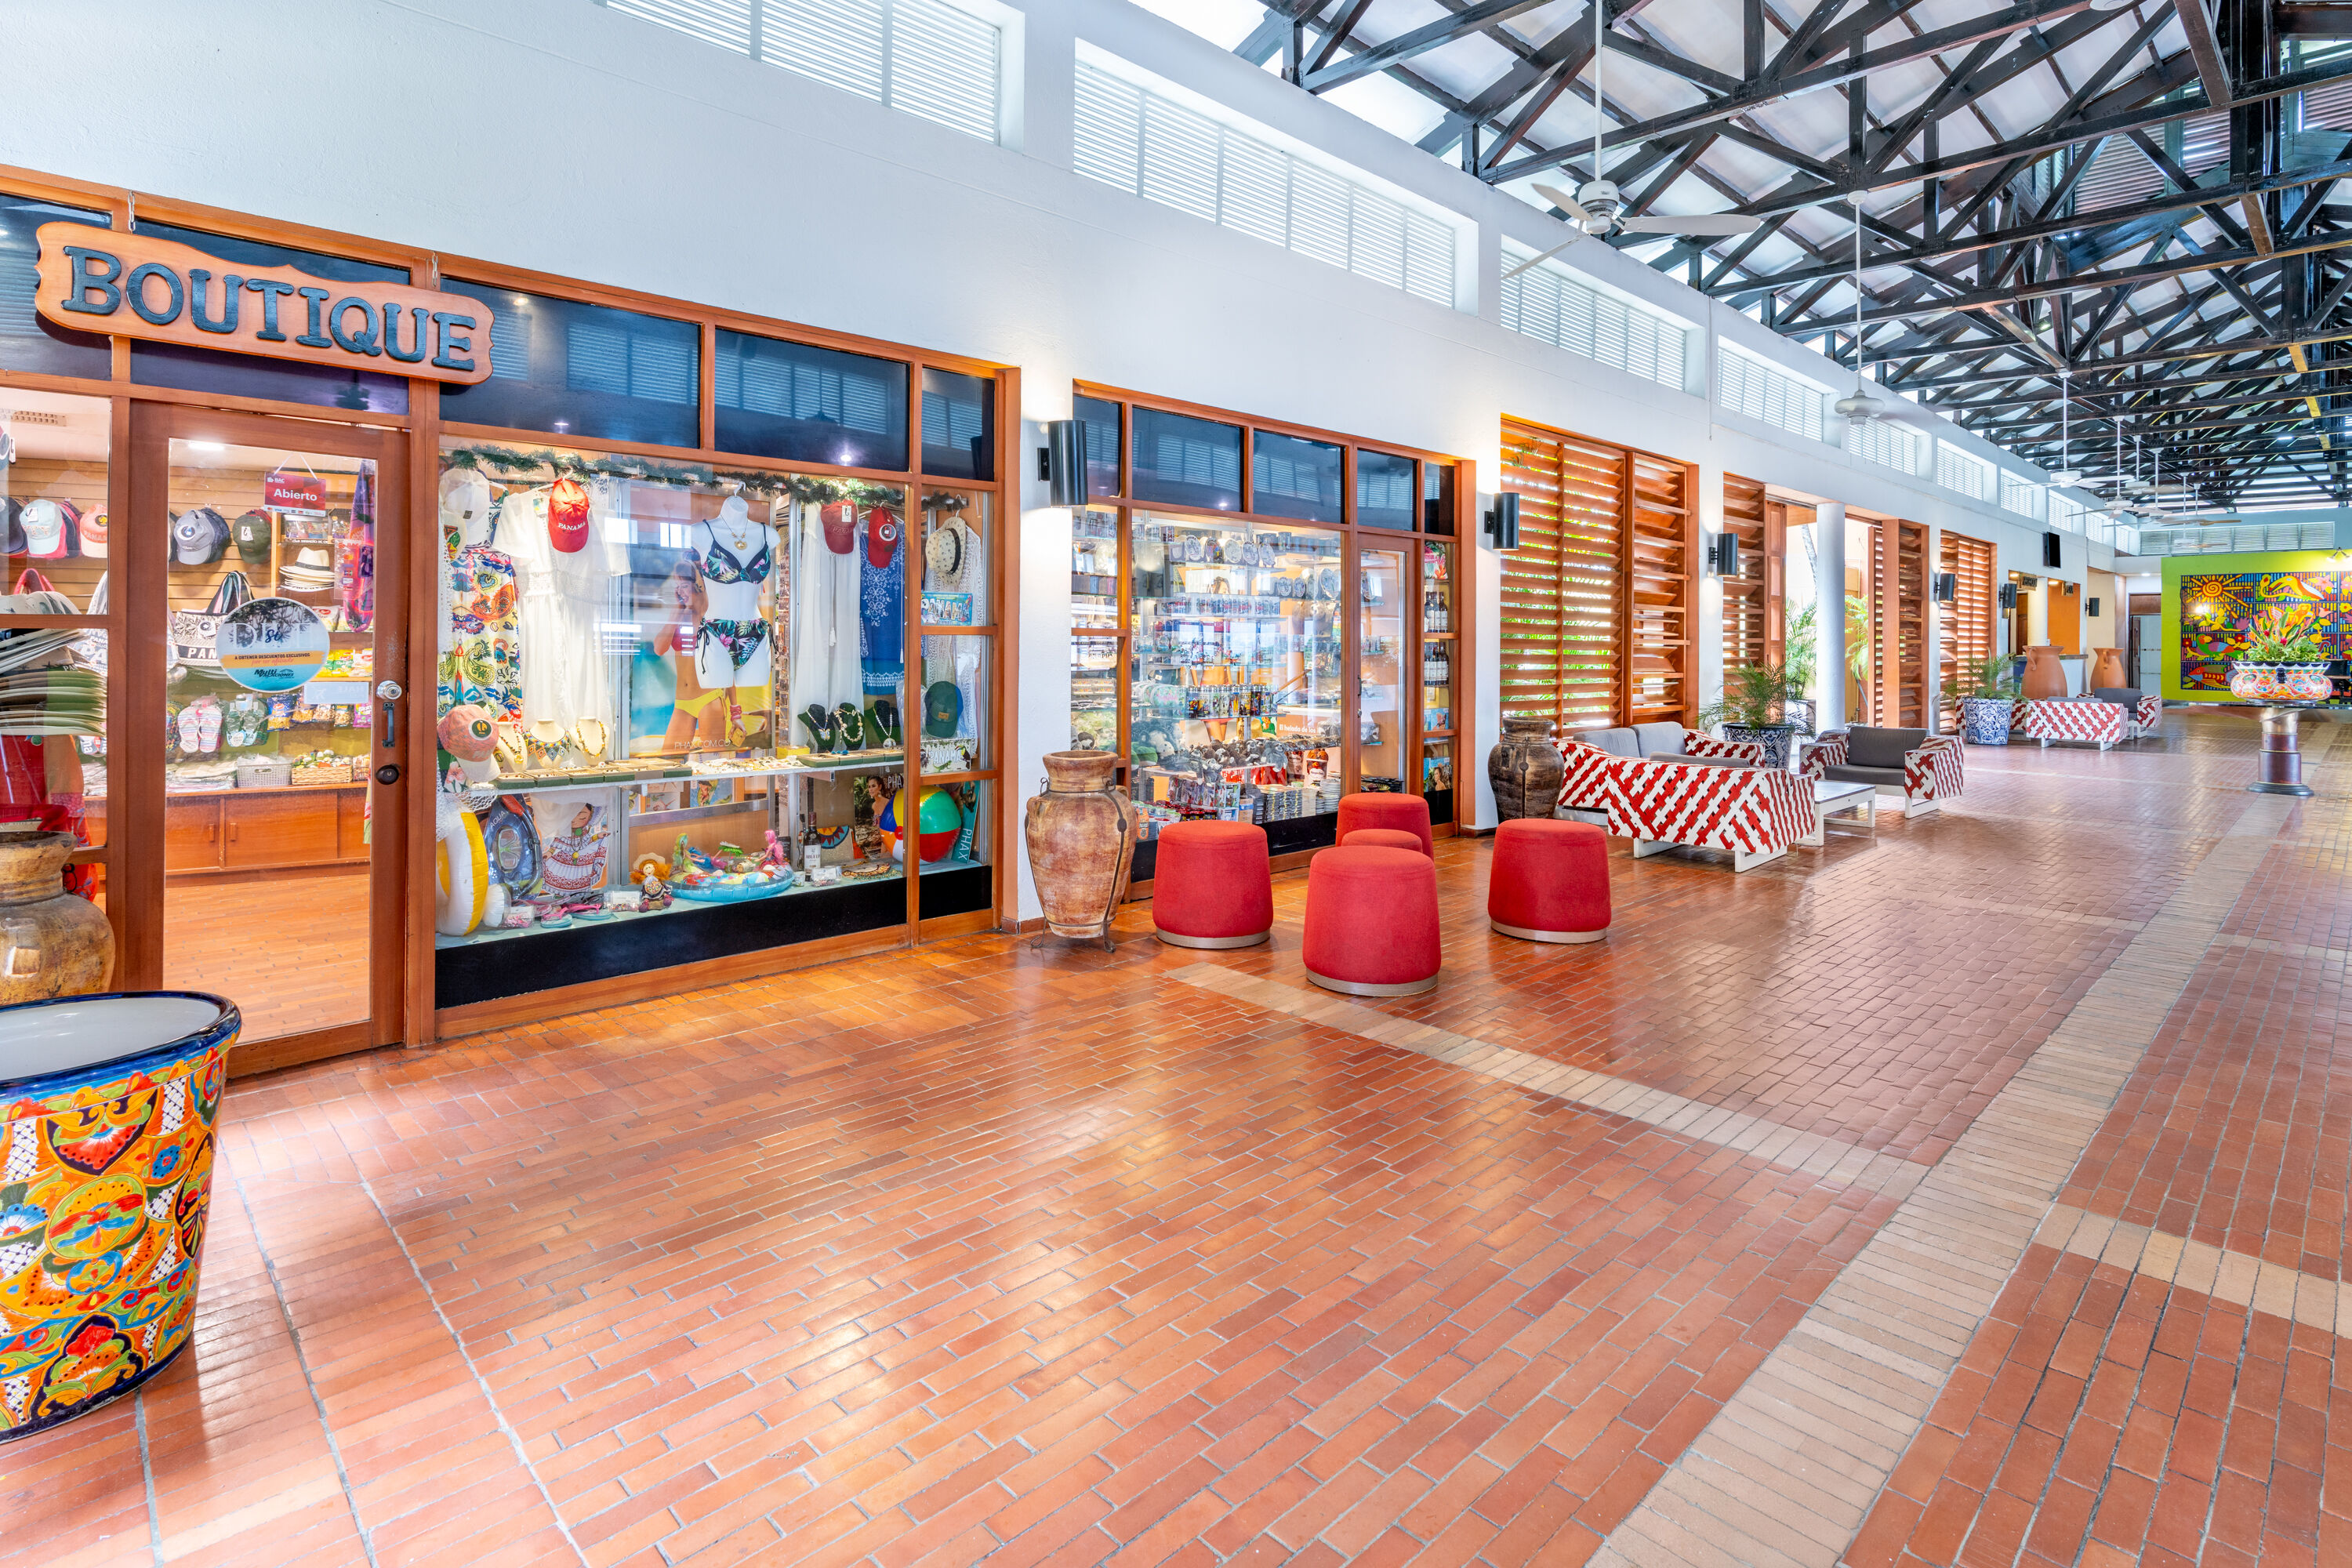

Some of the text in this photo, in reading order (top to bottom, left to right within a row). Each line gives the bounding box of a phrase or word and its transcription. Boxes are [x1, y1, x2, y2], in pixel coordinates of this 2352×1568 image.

[60, 245, 477, 372] BOUTIQUE
[274, 488, 318, 501] Abierto
[557, 521, 586, 531] PANAMA
[928, 748, 962, 765] PANAMA
[958, 828, 973, 861] PHAX
